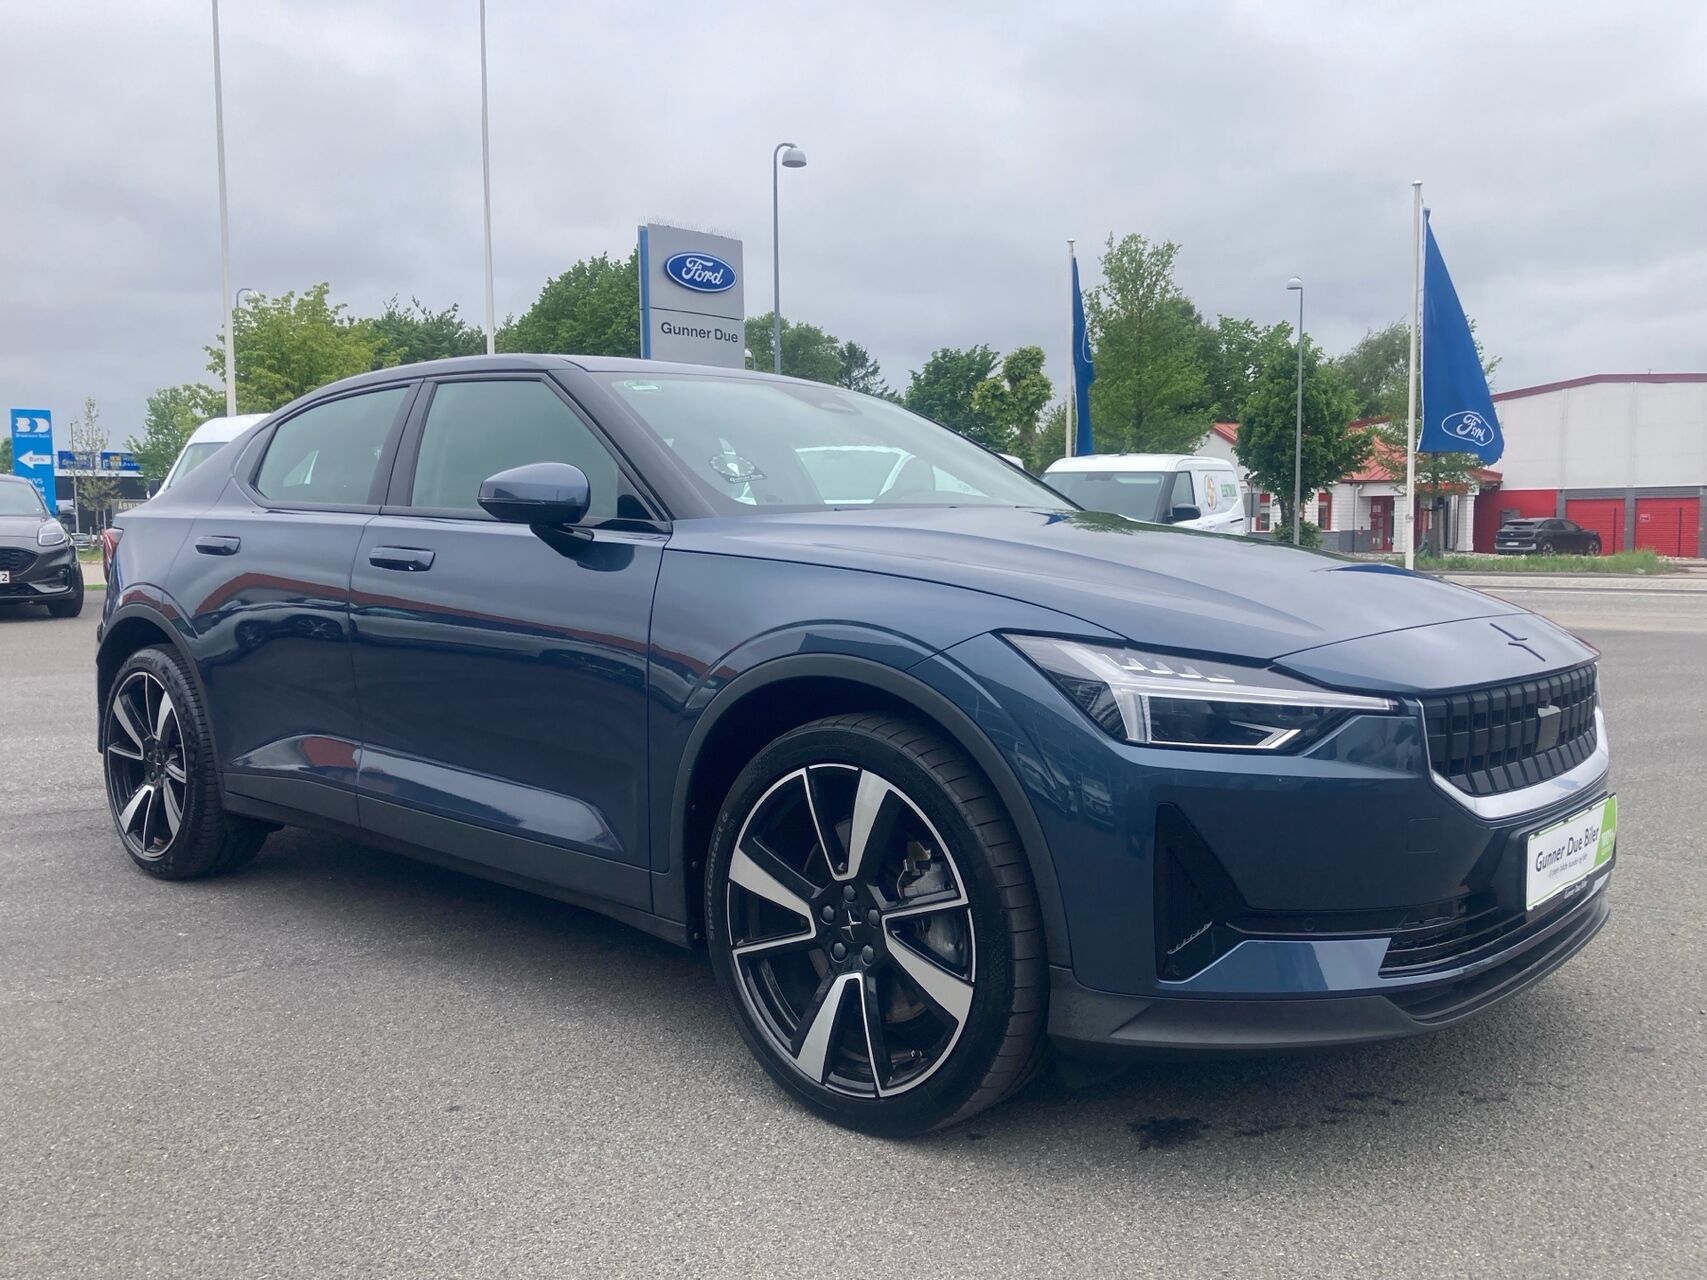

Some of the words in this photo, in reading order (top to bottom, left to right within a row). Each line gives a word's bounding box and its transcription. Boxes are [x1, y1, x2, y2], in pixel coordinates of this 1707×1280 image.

[682, 257, 724, 285] Ford
[661, 321, 711, 339] Gunner
[714, 328, 738, 343] Due
[1535, 846, 1565, 872] Gunner
[1567, 836, 1582, 857] Due
[1584, 825, 1599, 848] Biler
